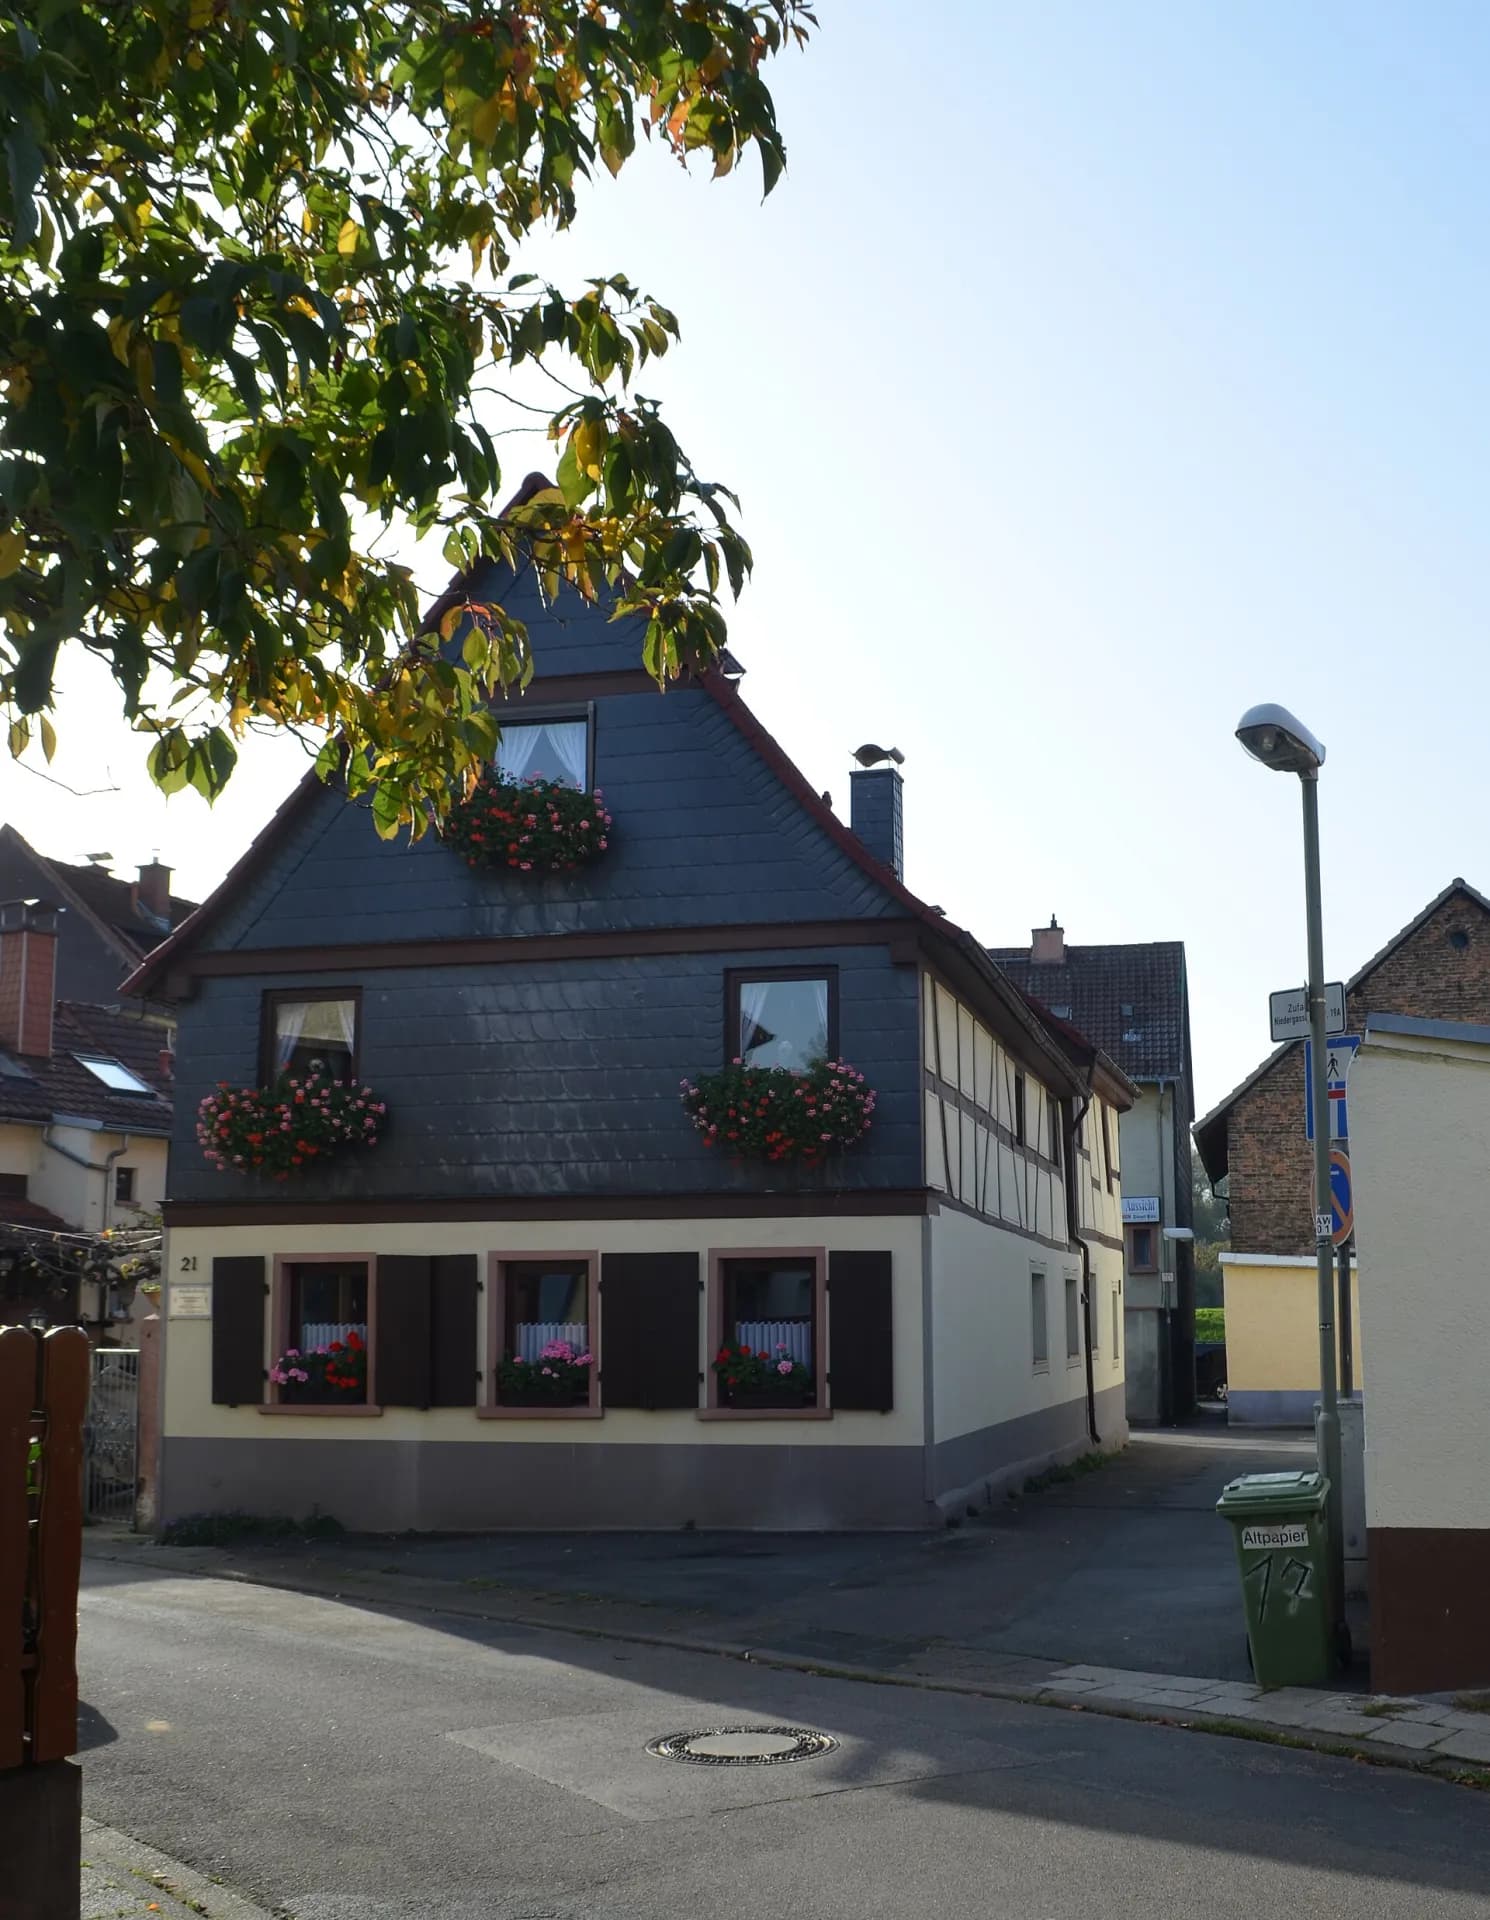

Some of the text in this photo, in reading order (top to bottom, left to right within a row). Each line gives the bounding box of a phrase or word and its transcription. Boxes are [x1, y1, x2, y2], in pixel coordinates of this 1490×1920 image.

[1273, 1014, 1308, 1026] Niedergass
[180, 1256, 197, 1271] 21
[1244, 1528, 1306, 1547] Altpapier
[1245, 1553, 1313, 1625] 17
